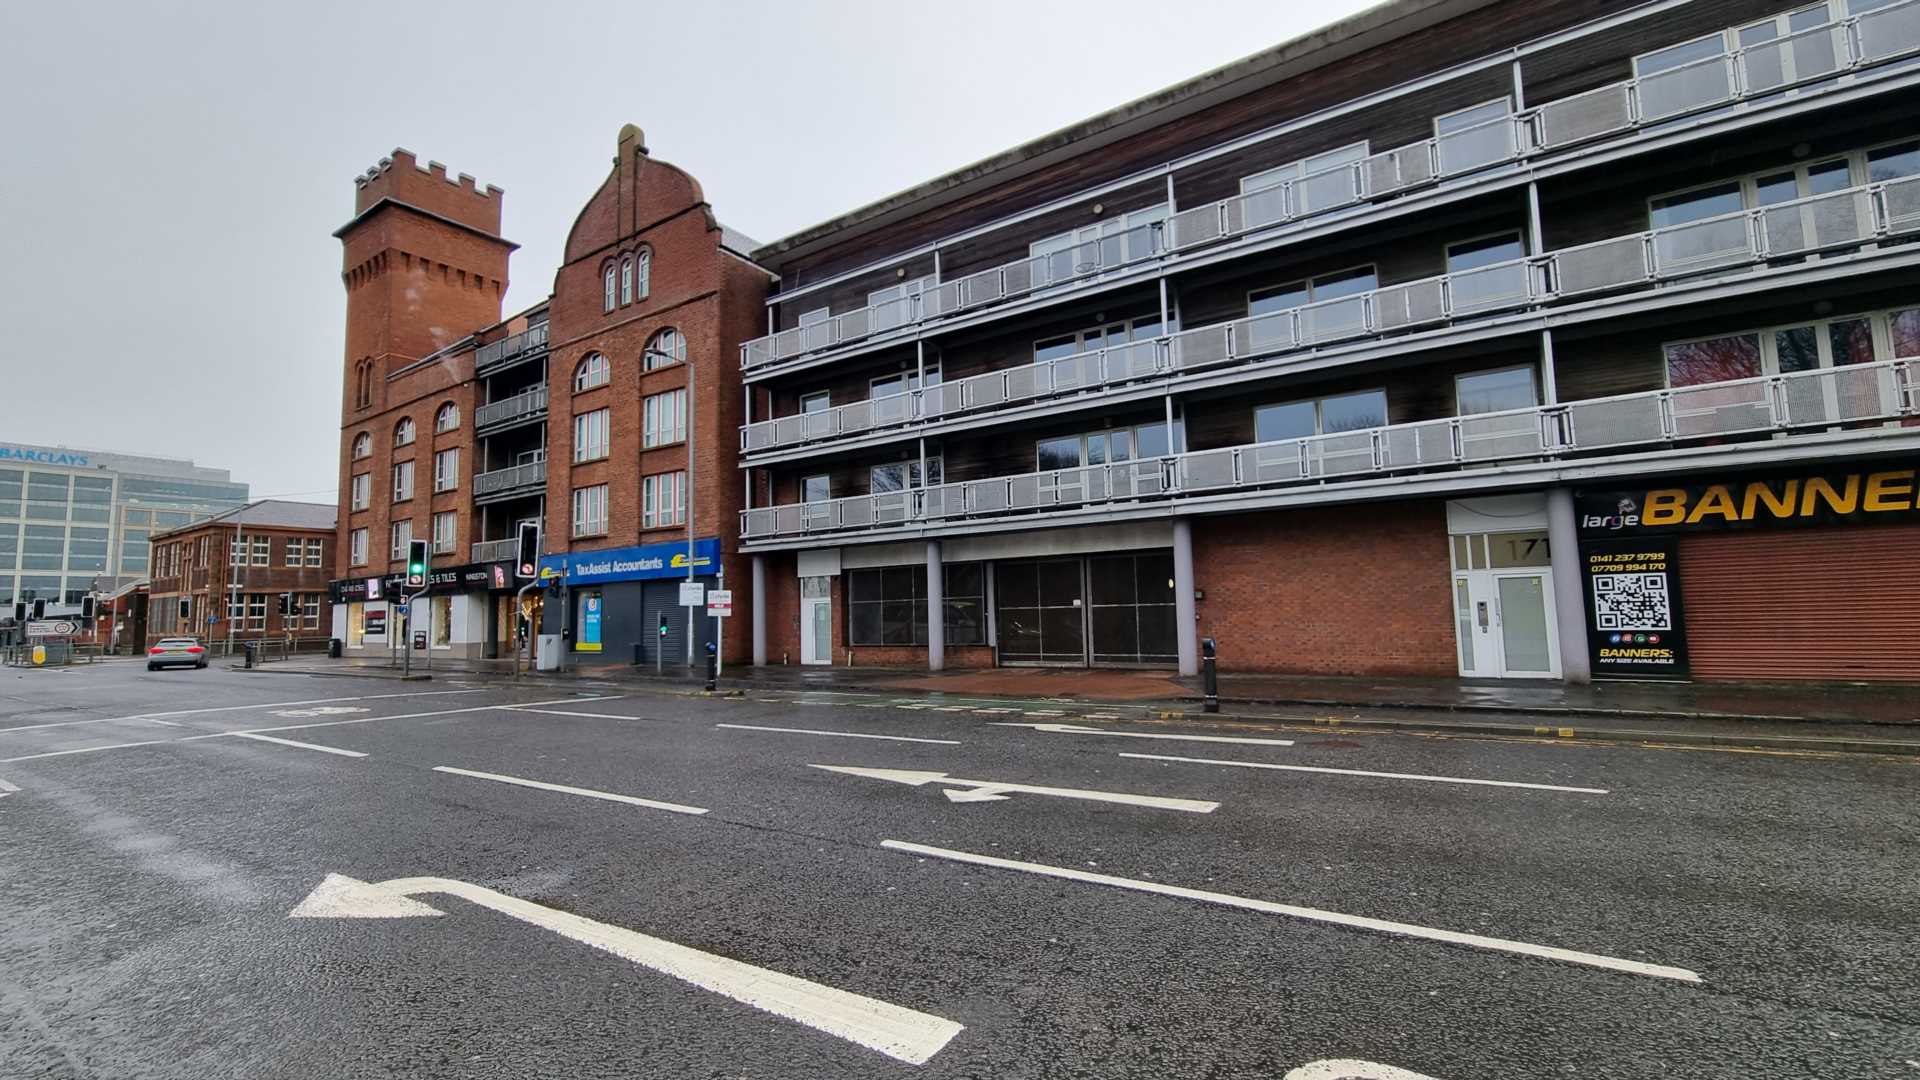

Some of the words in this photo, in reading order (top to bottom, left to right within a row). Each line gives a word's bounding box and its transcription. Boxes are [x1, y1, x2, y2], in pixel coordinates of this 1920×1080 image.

[0, 447, 88, 465] BARCLAYS
[1582, 513, 1639, 530] large
[1641, 470, 1920, 526] BANNE
[1590, 555, 1612, 563] 0141
[1614, 553, 1635, 562] 237
[1636, 552, 1665, 561] 9799
[576, 561, 611, 576] TaxAssist
[612, 557, 663, 572] Accountants
[1591, 564, 1623, 573] 07709
[1625, 563, 1647, 572] 994
[1648, 562, 1666, 571] 170
[441, 572, 457, 583] TILES
[1600, 648, 1674, 658] BANNERS:
